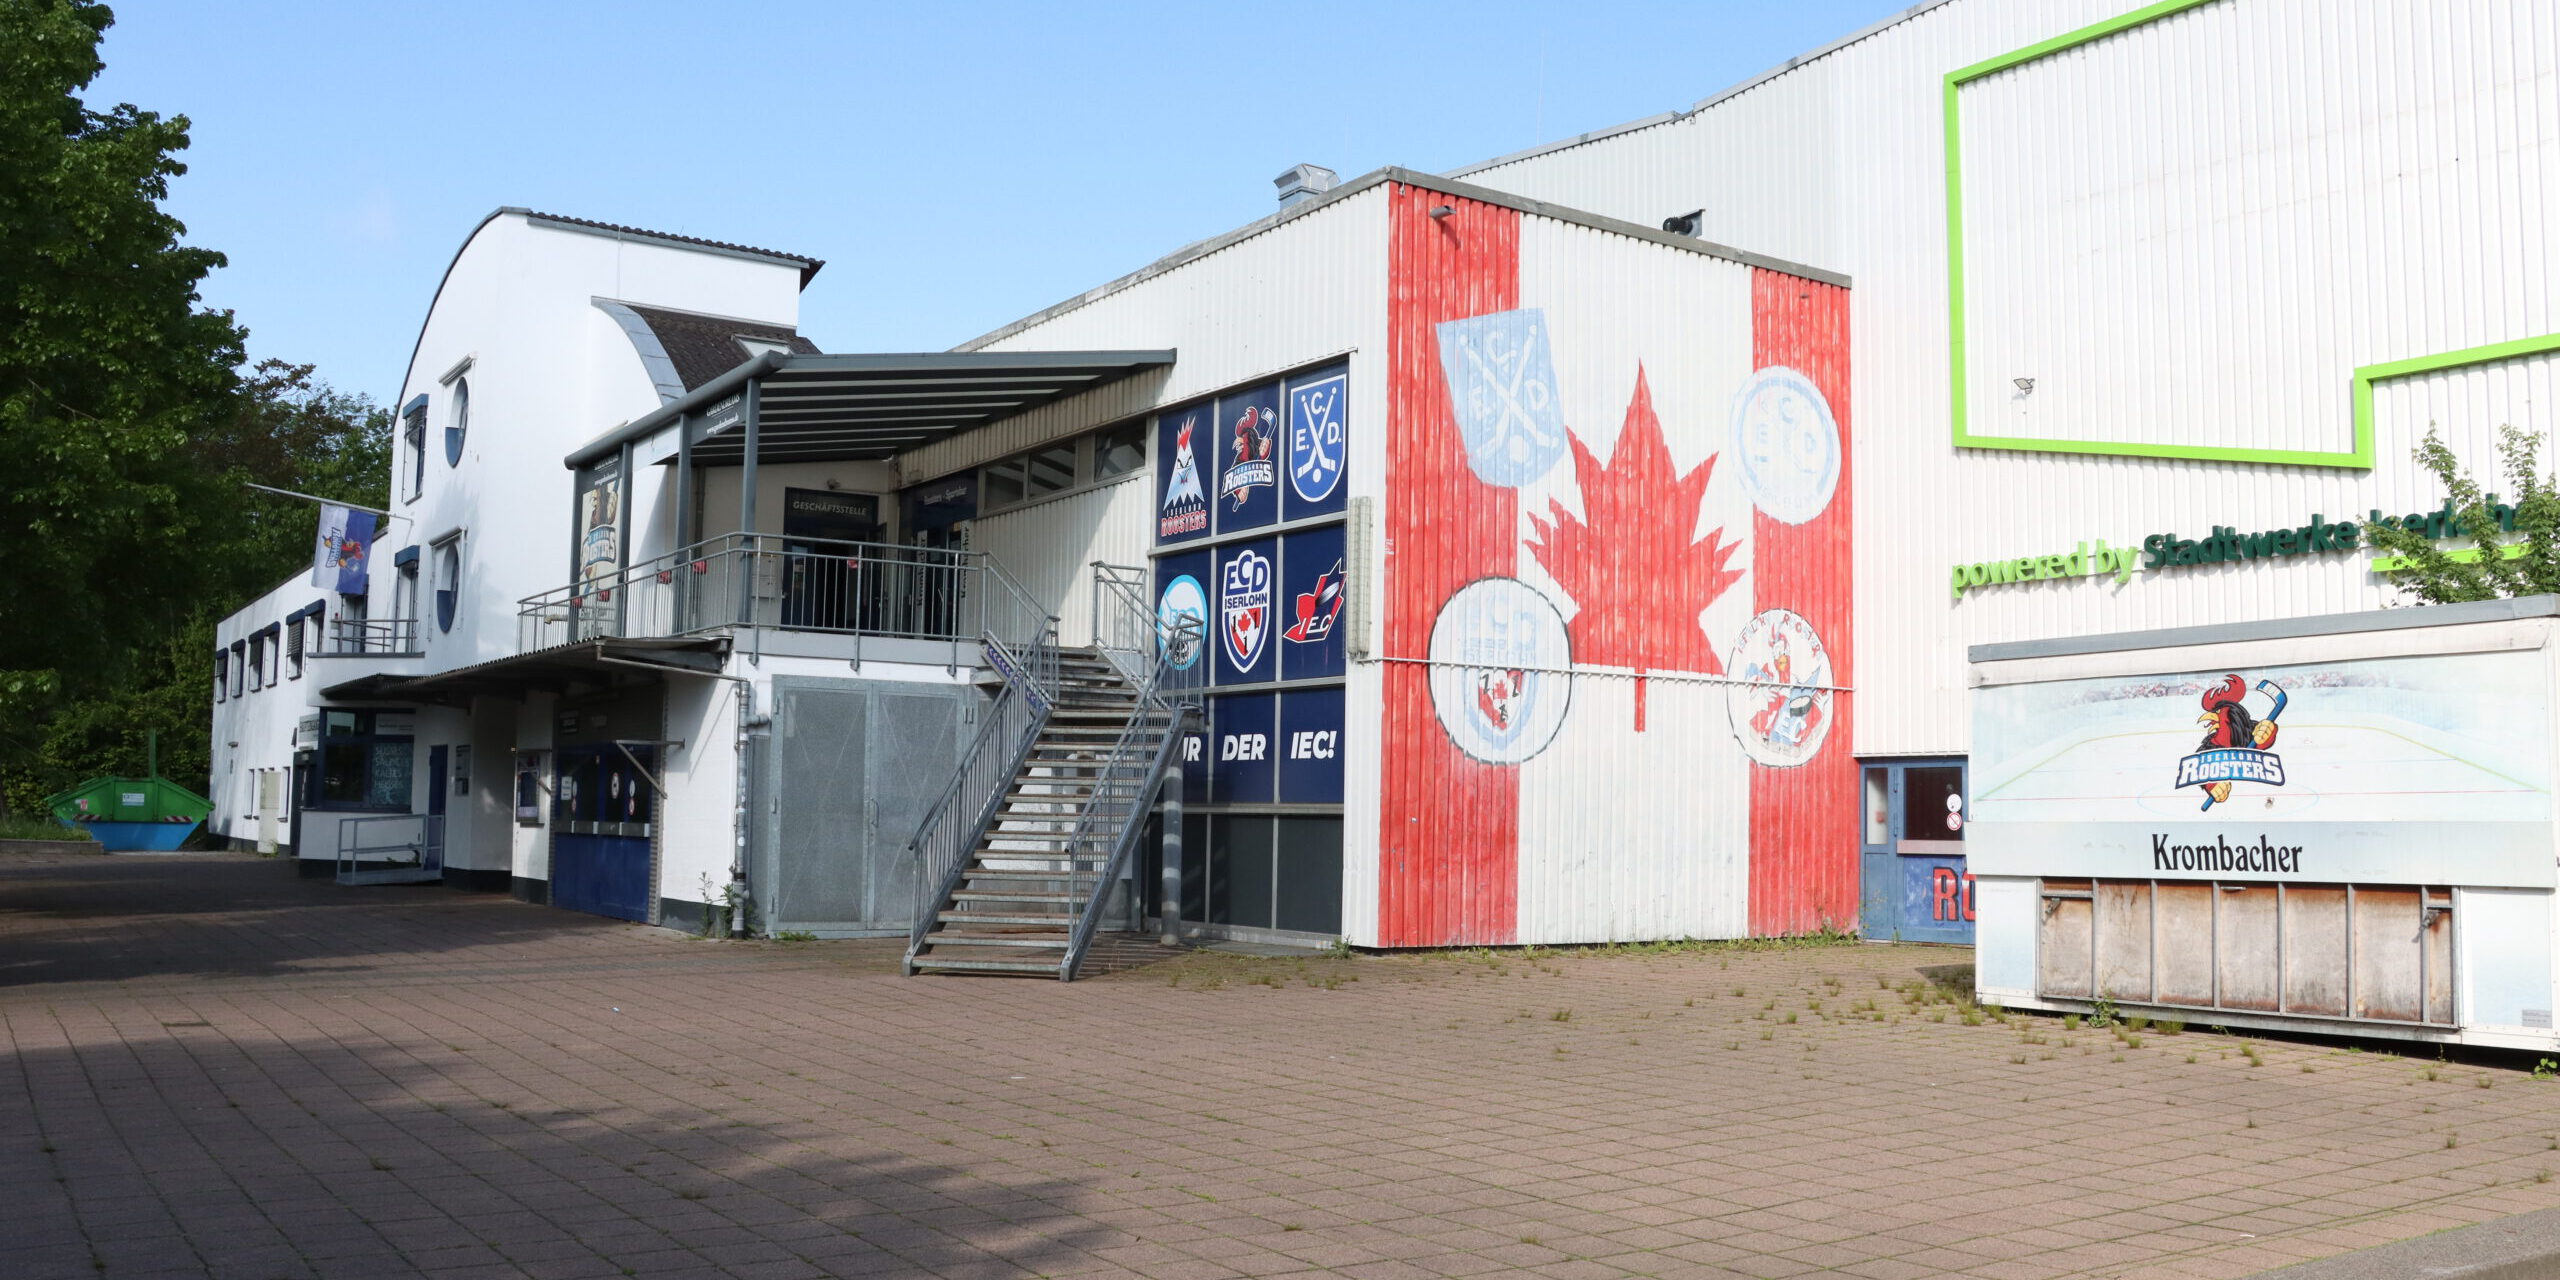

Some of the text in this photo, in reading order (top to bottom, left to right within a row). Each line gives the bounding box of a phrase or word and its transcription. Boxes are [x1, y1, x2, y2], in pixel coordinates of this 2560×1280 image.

[1223, 463, 1273, 494] ROOSTERS
[1161, 510, 1207, 537] ROOSTERS
[1952, 541, 2088, 598] powered
[2096, 538, 2139, 585] by
[2144, 514, 2360, 569] Stadtwerke
[1225, 553, 1268, 596] ECD
[1224, 592, 1267, 610] ISERLOHN
[1298, 614, 1331, 635] IEC
[1221, 733, 1266, 761] DER
[1290, 730, 1337, 760] IEC!
[2200, 752, 2262, 764] ISERLOHN
[2178, 755, 2283, 786] ROOSTERS
[2152, 833, 2303, 873] Krombacher
